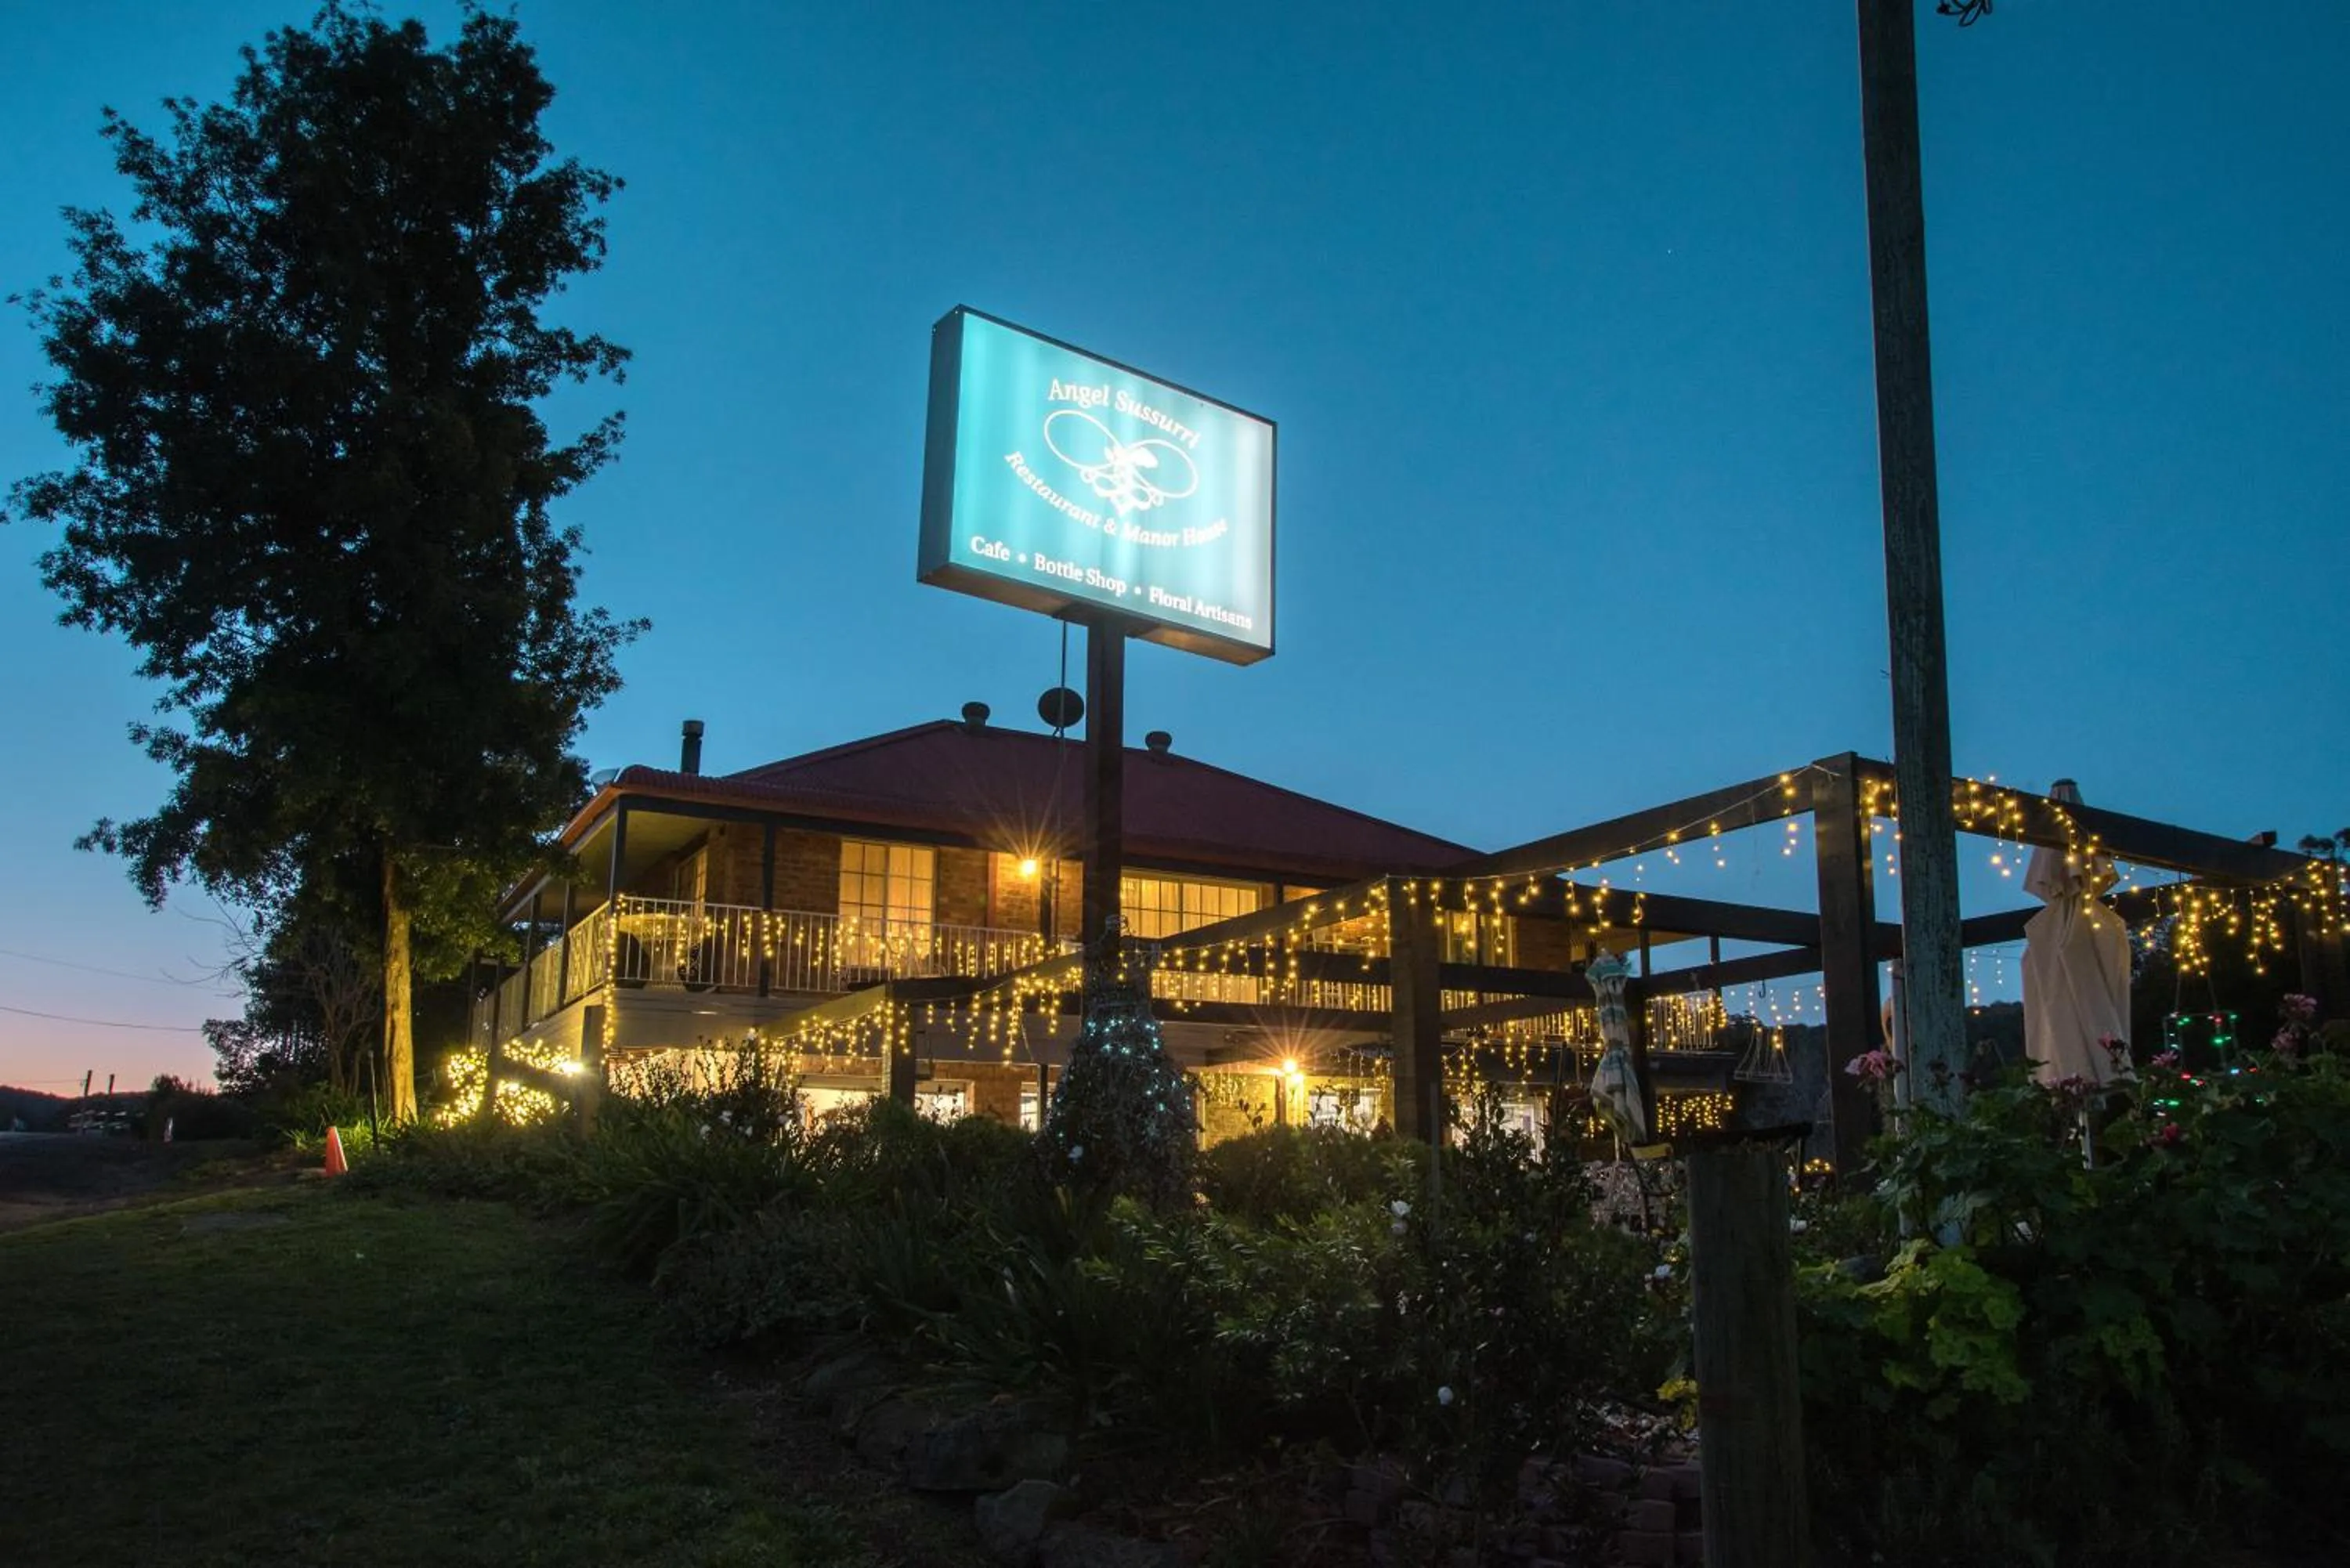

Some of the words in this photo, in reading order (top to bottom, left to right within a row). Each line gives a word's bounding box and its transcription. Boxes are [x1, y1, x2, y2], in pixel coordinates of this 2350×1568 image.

[1049, 378, 1109, 408] Angel
[1004, 451, 1101, 528] Restaurant
[1104, 518, 1116, 535] &
[1123, 522, 1179, 547] Manor
[971, 537, 1010, 561] Cafe
[1035, 553, 1083, 581] Bottle
[1086, 569, 1126, 597] Shop
[1149, 586, 1192, 612] Floral
[1194, 600, 1253, 630] Artisans
